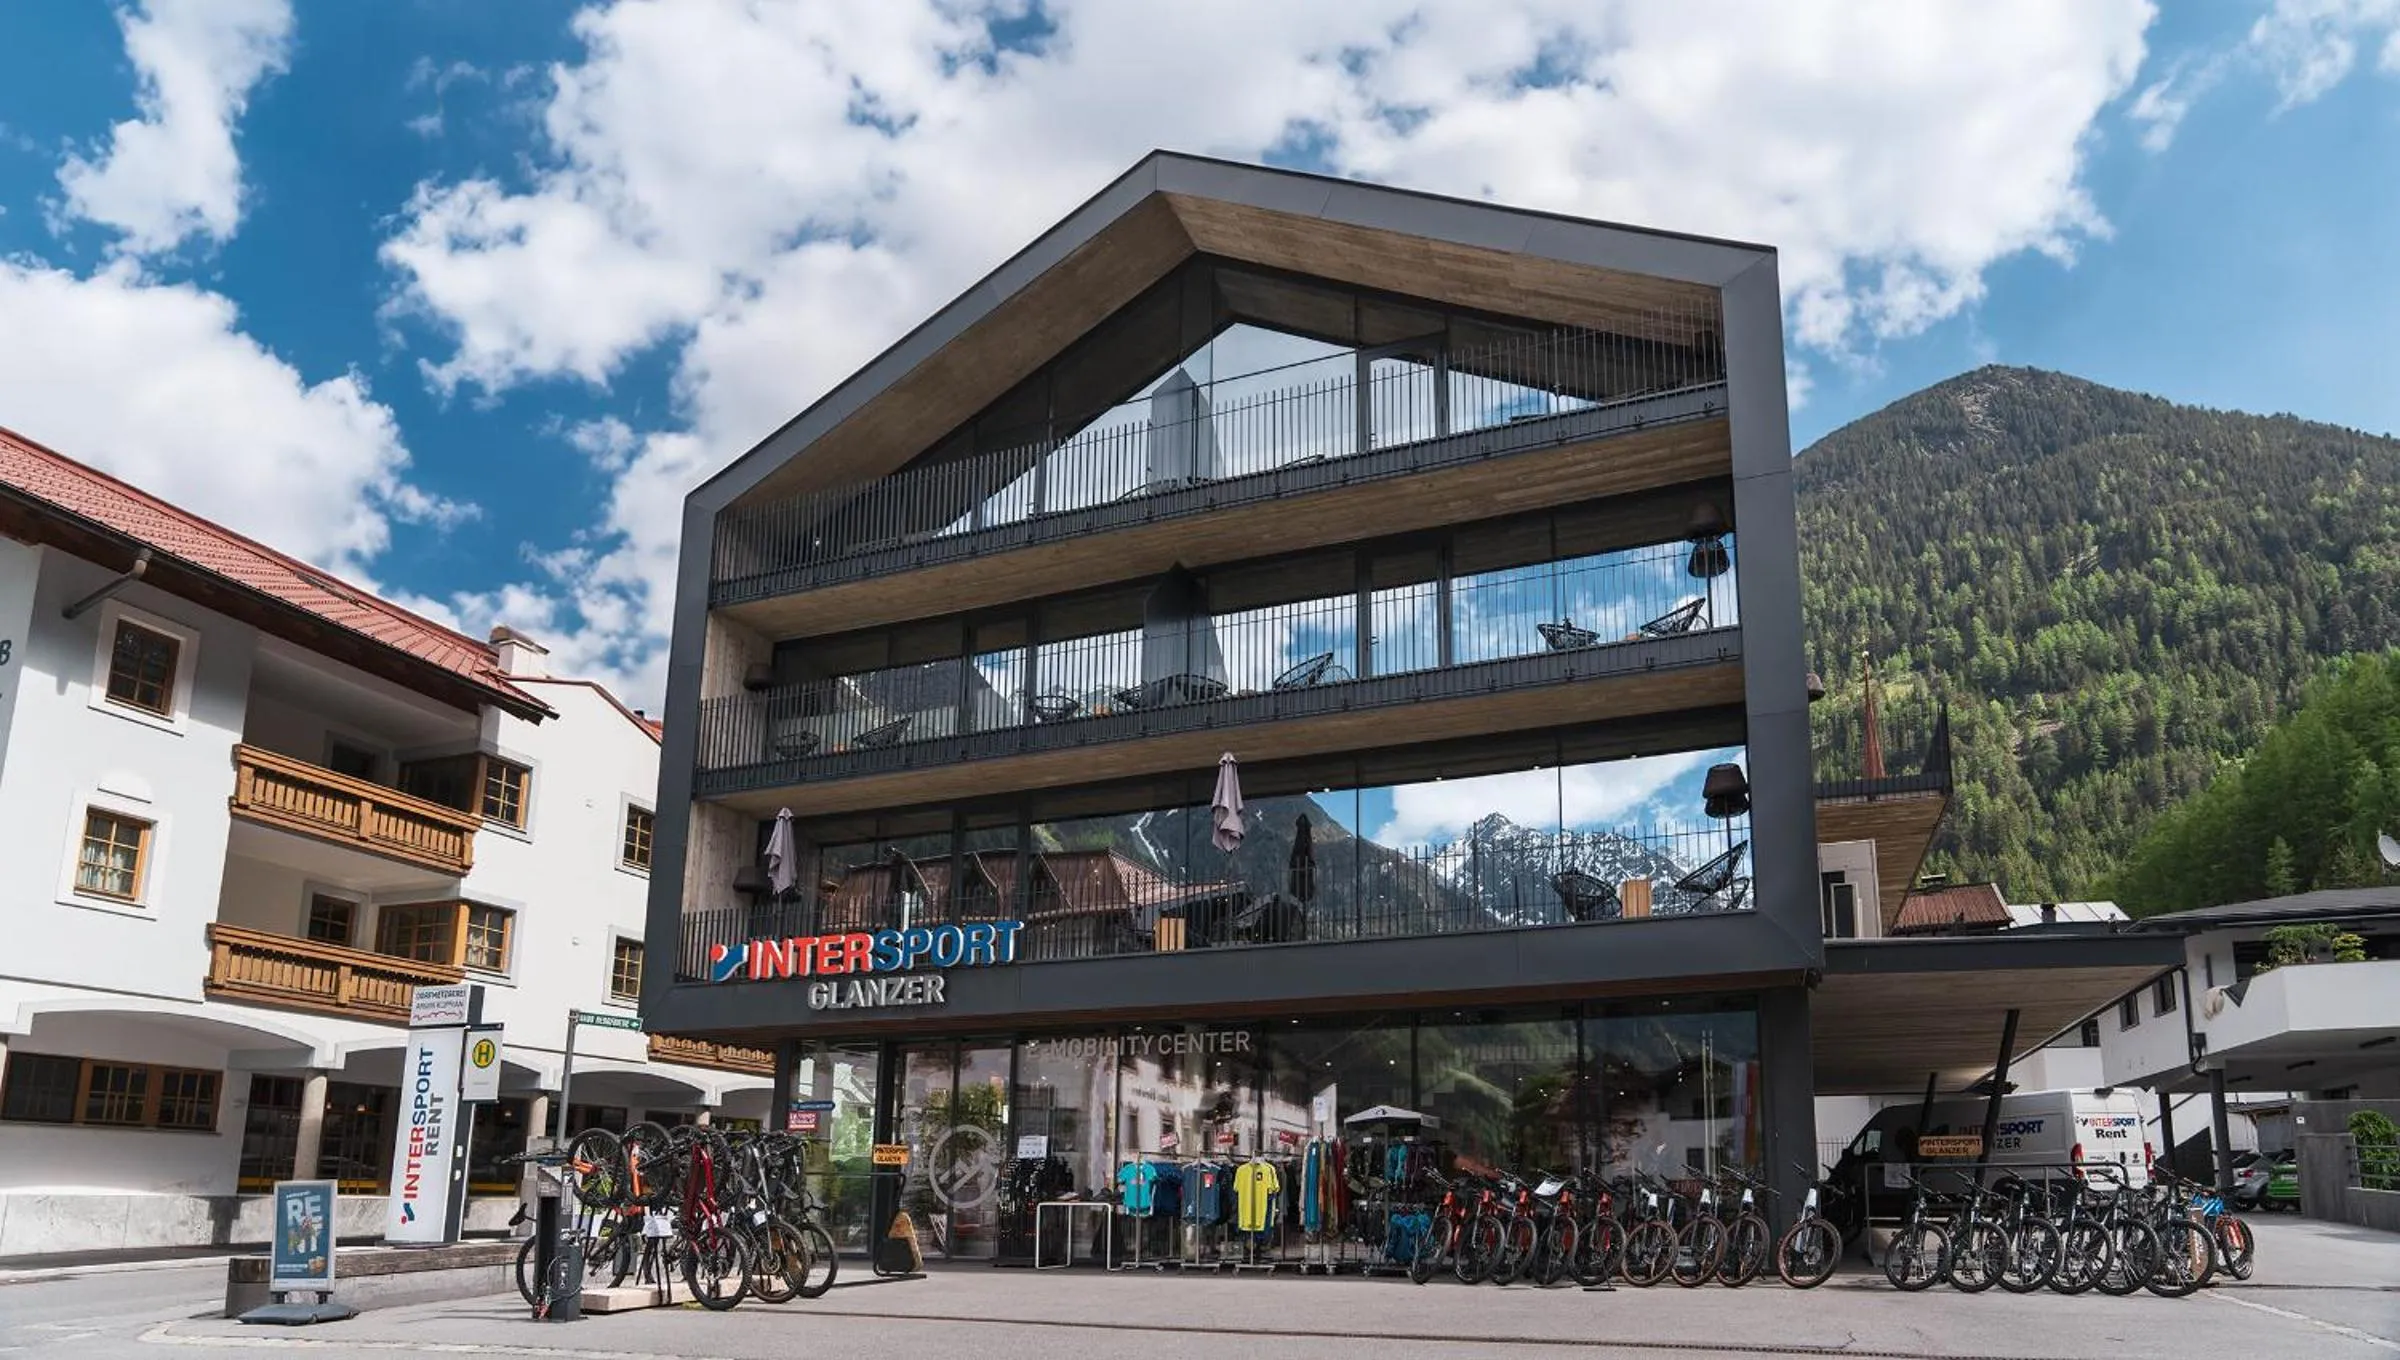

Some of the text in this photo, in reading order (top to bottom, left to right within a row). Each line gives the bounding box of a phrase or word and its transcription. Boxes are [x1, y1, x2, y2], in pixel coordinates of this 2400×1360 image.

[749, 920, 1024, 981] INTERSPORT
[808, 974, 945, 1010] GLANZER
[1158, 1031, 1250, 1055] CENTER
[404, 1047, 433, 1199] INTERSPORT
[425, 1093, 444, 1156] RENT
[2088, 1117, 2136, 1128] INTERSPORT
[2095, 1128, 2127, 1139] Rent
